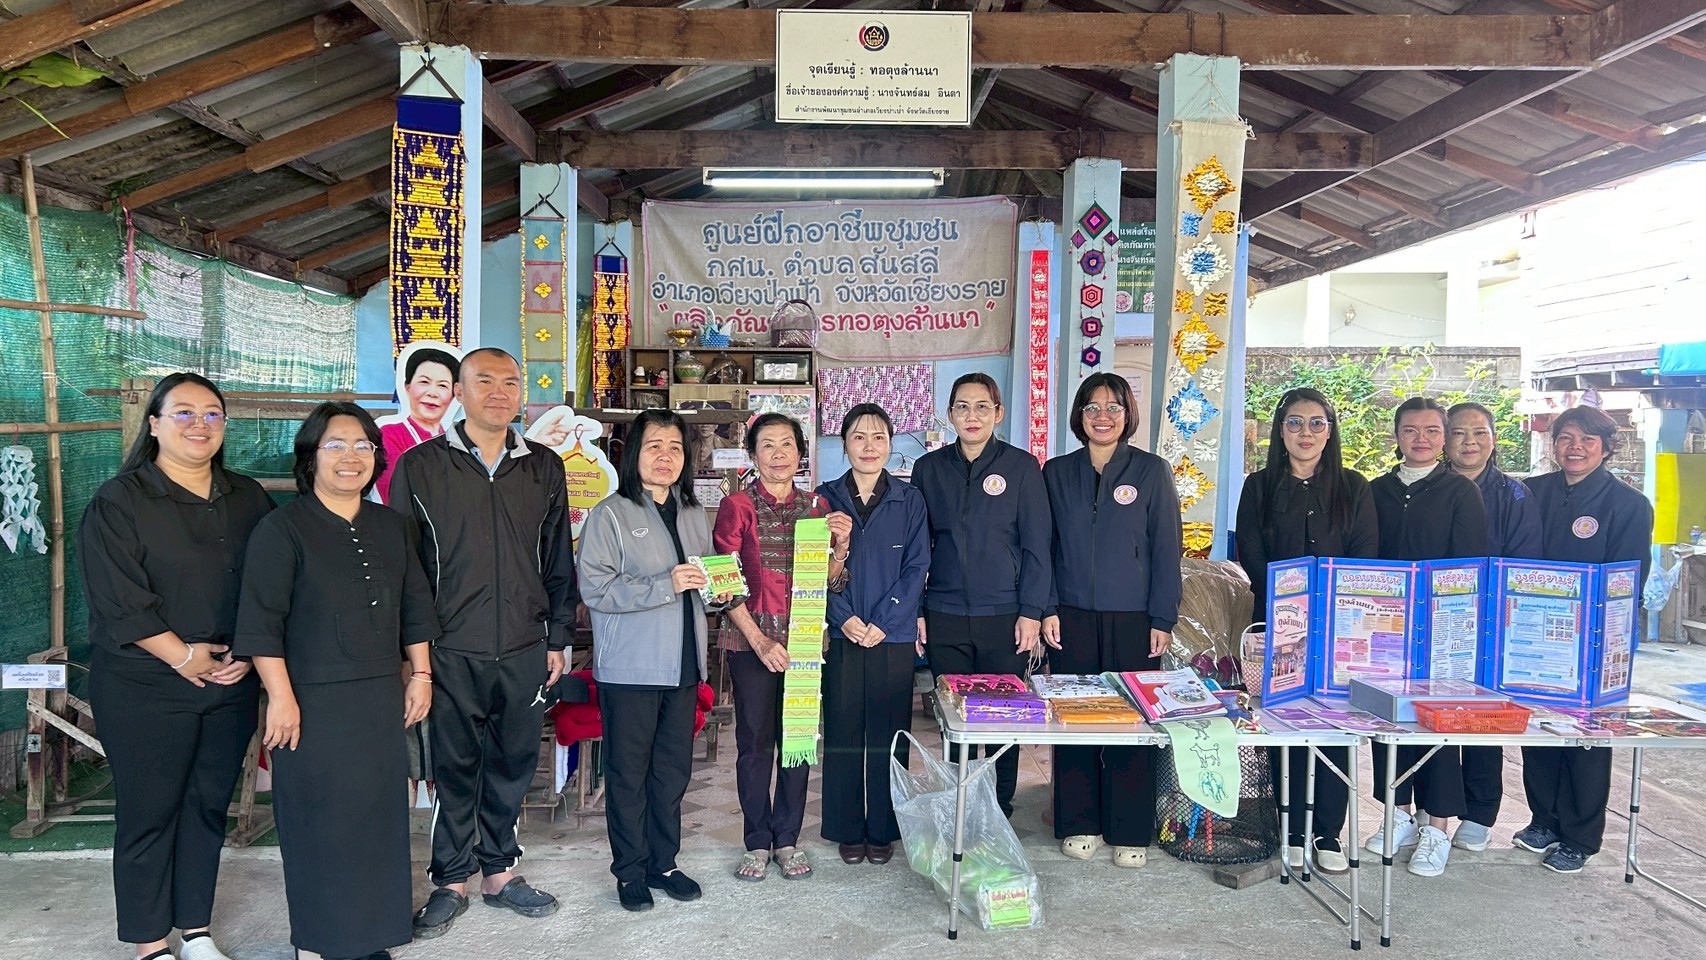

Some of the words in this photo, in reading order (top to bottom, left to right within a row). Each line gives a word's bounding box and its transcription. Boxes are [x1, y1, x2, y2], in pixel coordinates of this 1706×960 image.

[809, 62, 856, 79] จุดเรียนรู้
[869, 63, 939, 79] ทอตุงล้านนา
[702, 209, 959, 253] ศูนย์ฝึกอาชีพชุมชน
[706, 256, 774, 278] กศน.
[835, 276, 1007, 303] จังหวัดเชียงราย
